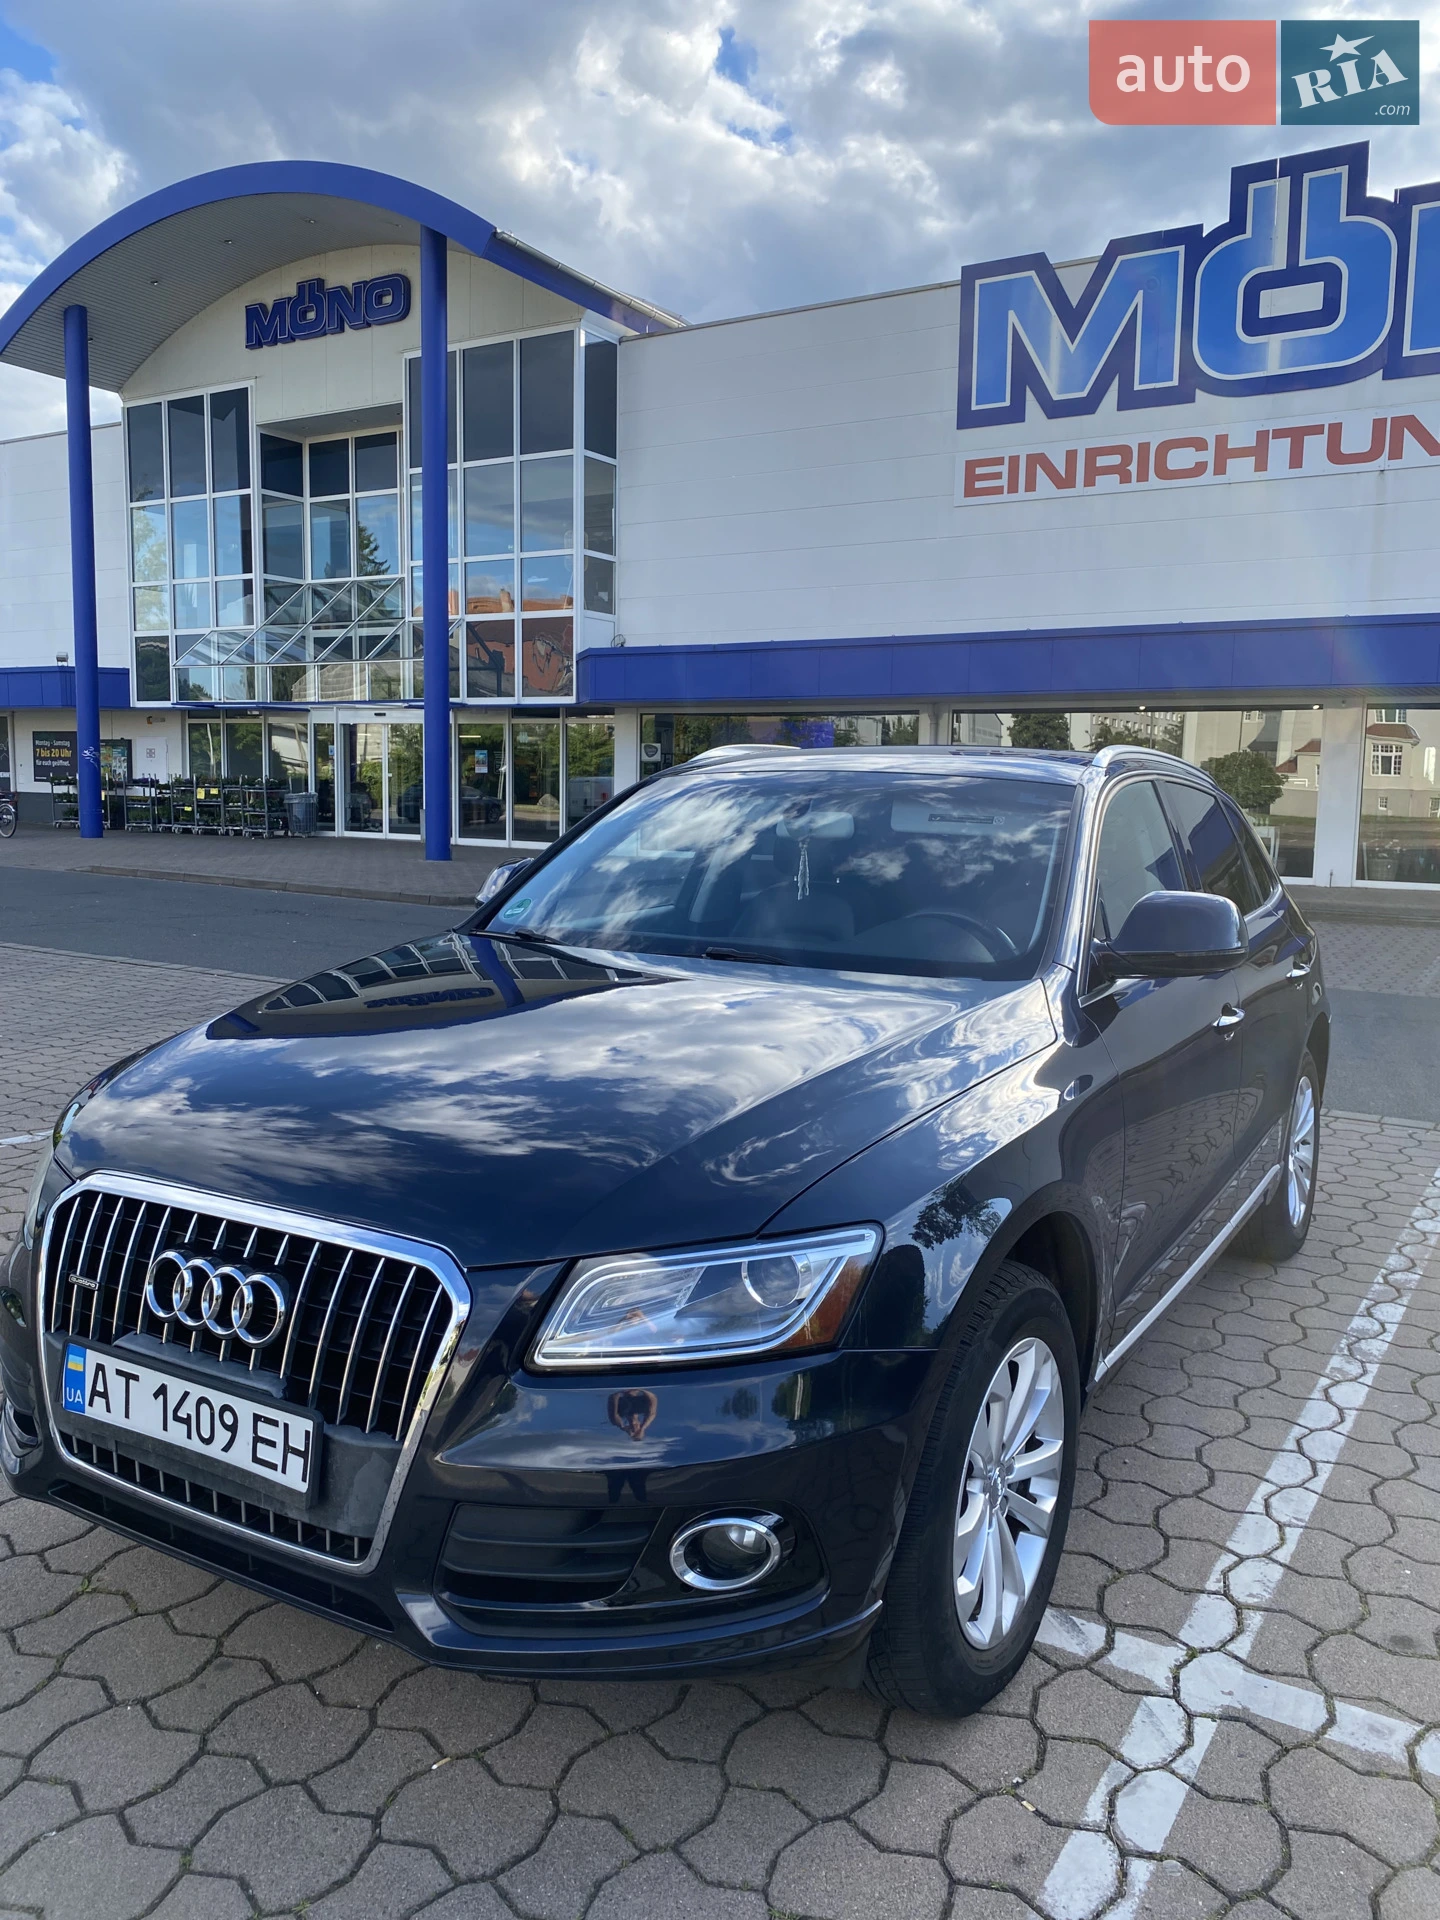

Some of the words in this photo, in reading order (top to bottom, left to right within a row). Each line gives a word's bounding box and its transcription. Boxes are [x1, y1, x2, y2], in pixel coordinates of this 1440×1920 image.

[36, 748, 40, 757] 7
[41, 747, 50, 757] bis
[51, 748, 60, 757] 20
[60, 748, 72, 757] Uhr
[66, 1386, 84, 1406] UA
[88, 1362, 140, 1419] AT
[152, 1382, 239, 1453] 1409
[251, 1412, 311, 1484] EH
